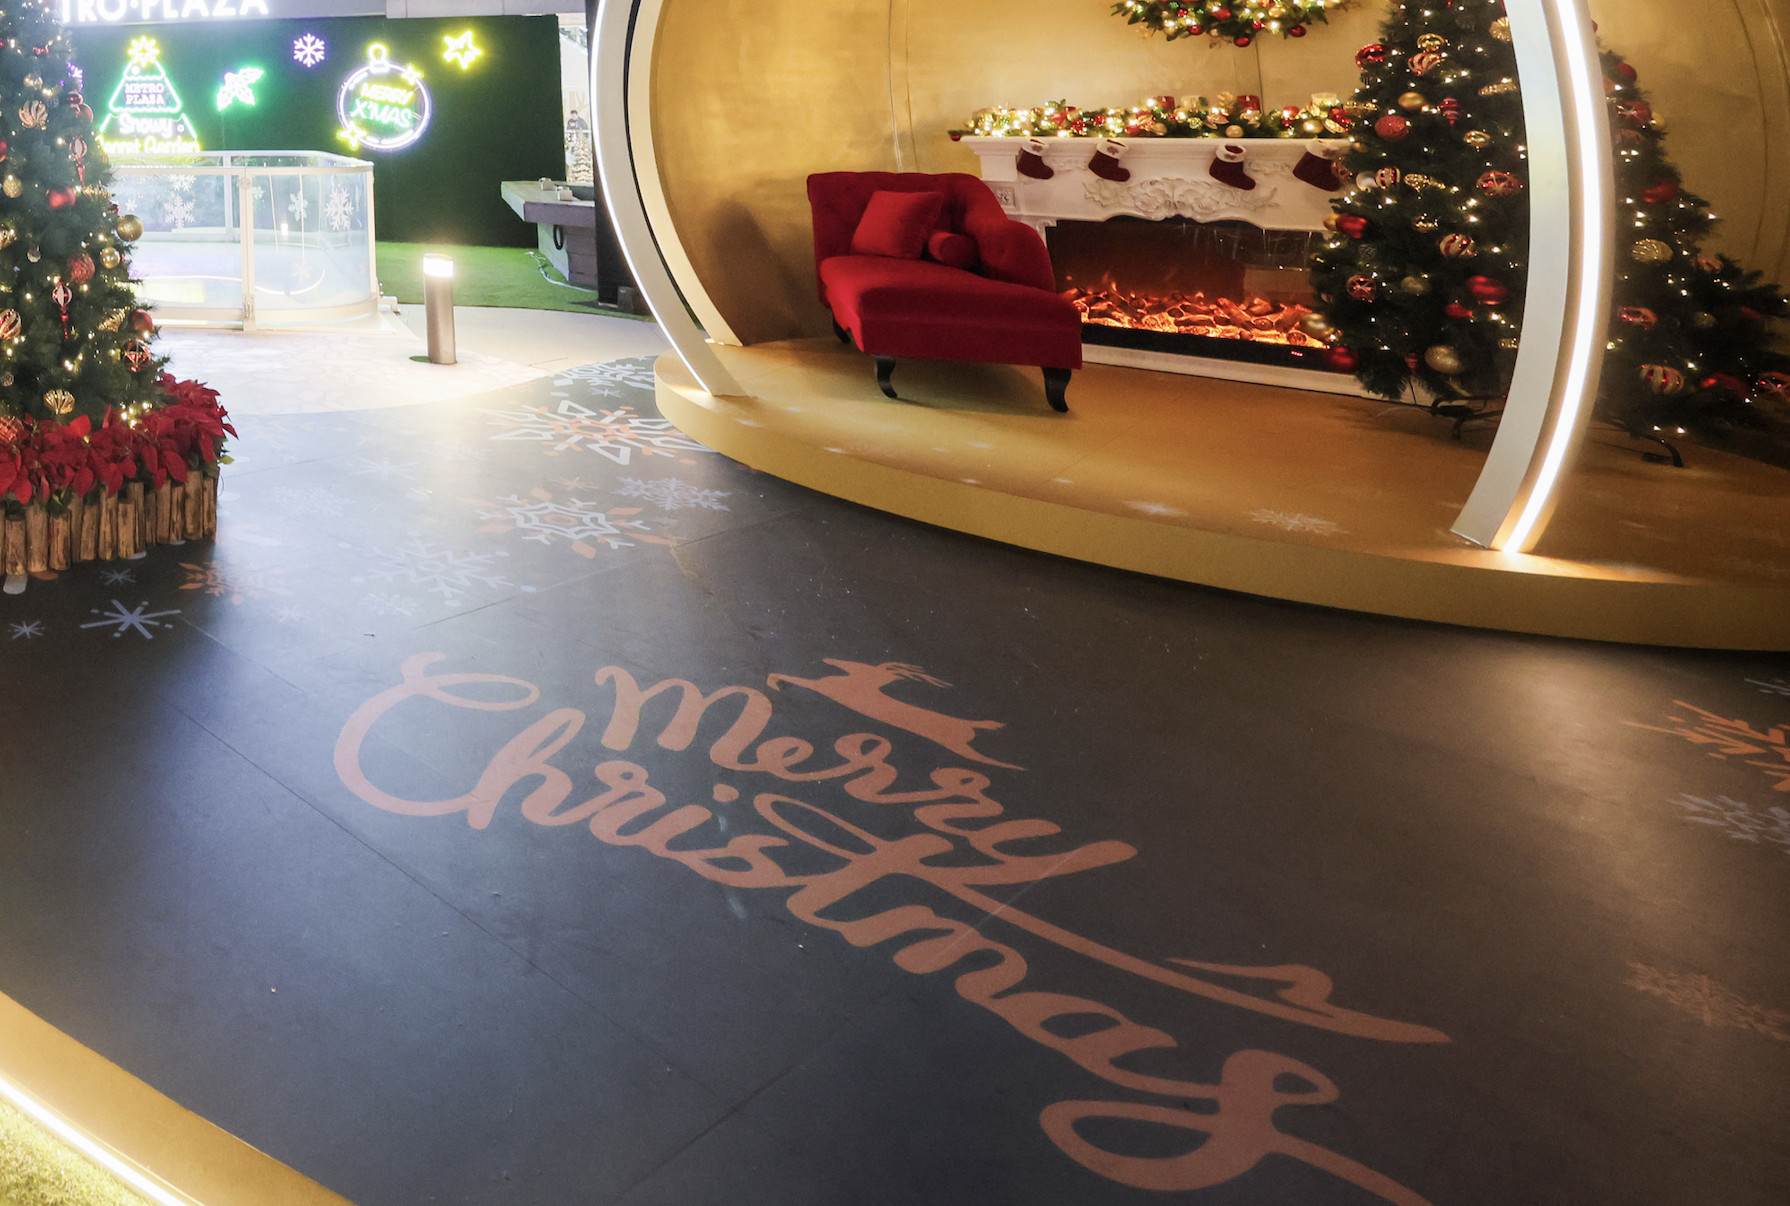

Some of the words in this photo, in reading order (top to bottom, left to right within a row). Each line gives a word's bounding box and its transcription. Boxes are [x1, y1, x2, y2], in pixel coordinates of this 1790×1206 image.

[124, 82, 165, 94] METRO
[125, 94, 165, 105] PLAZA
[360, 82, 414, 105] MERRY
[119, 113, 173, 139] Snowy
[350, 98, 413, 128] X'MAS
[594, 664, 1138, 886] Merry
[333, 651, 1453, 1206] Christmas
